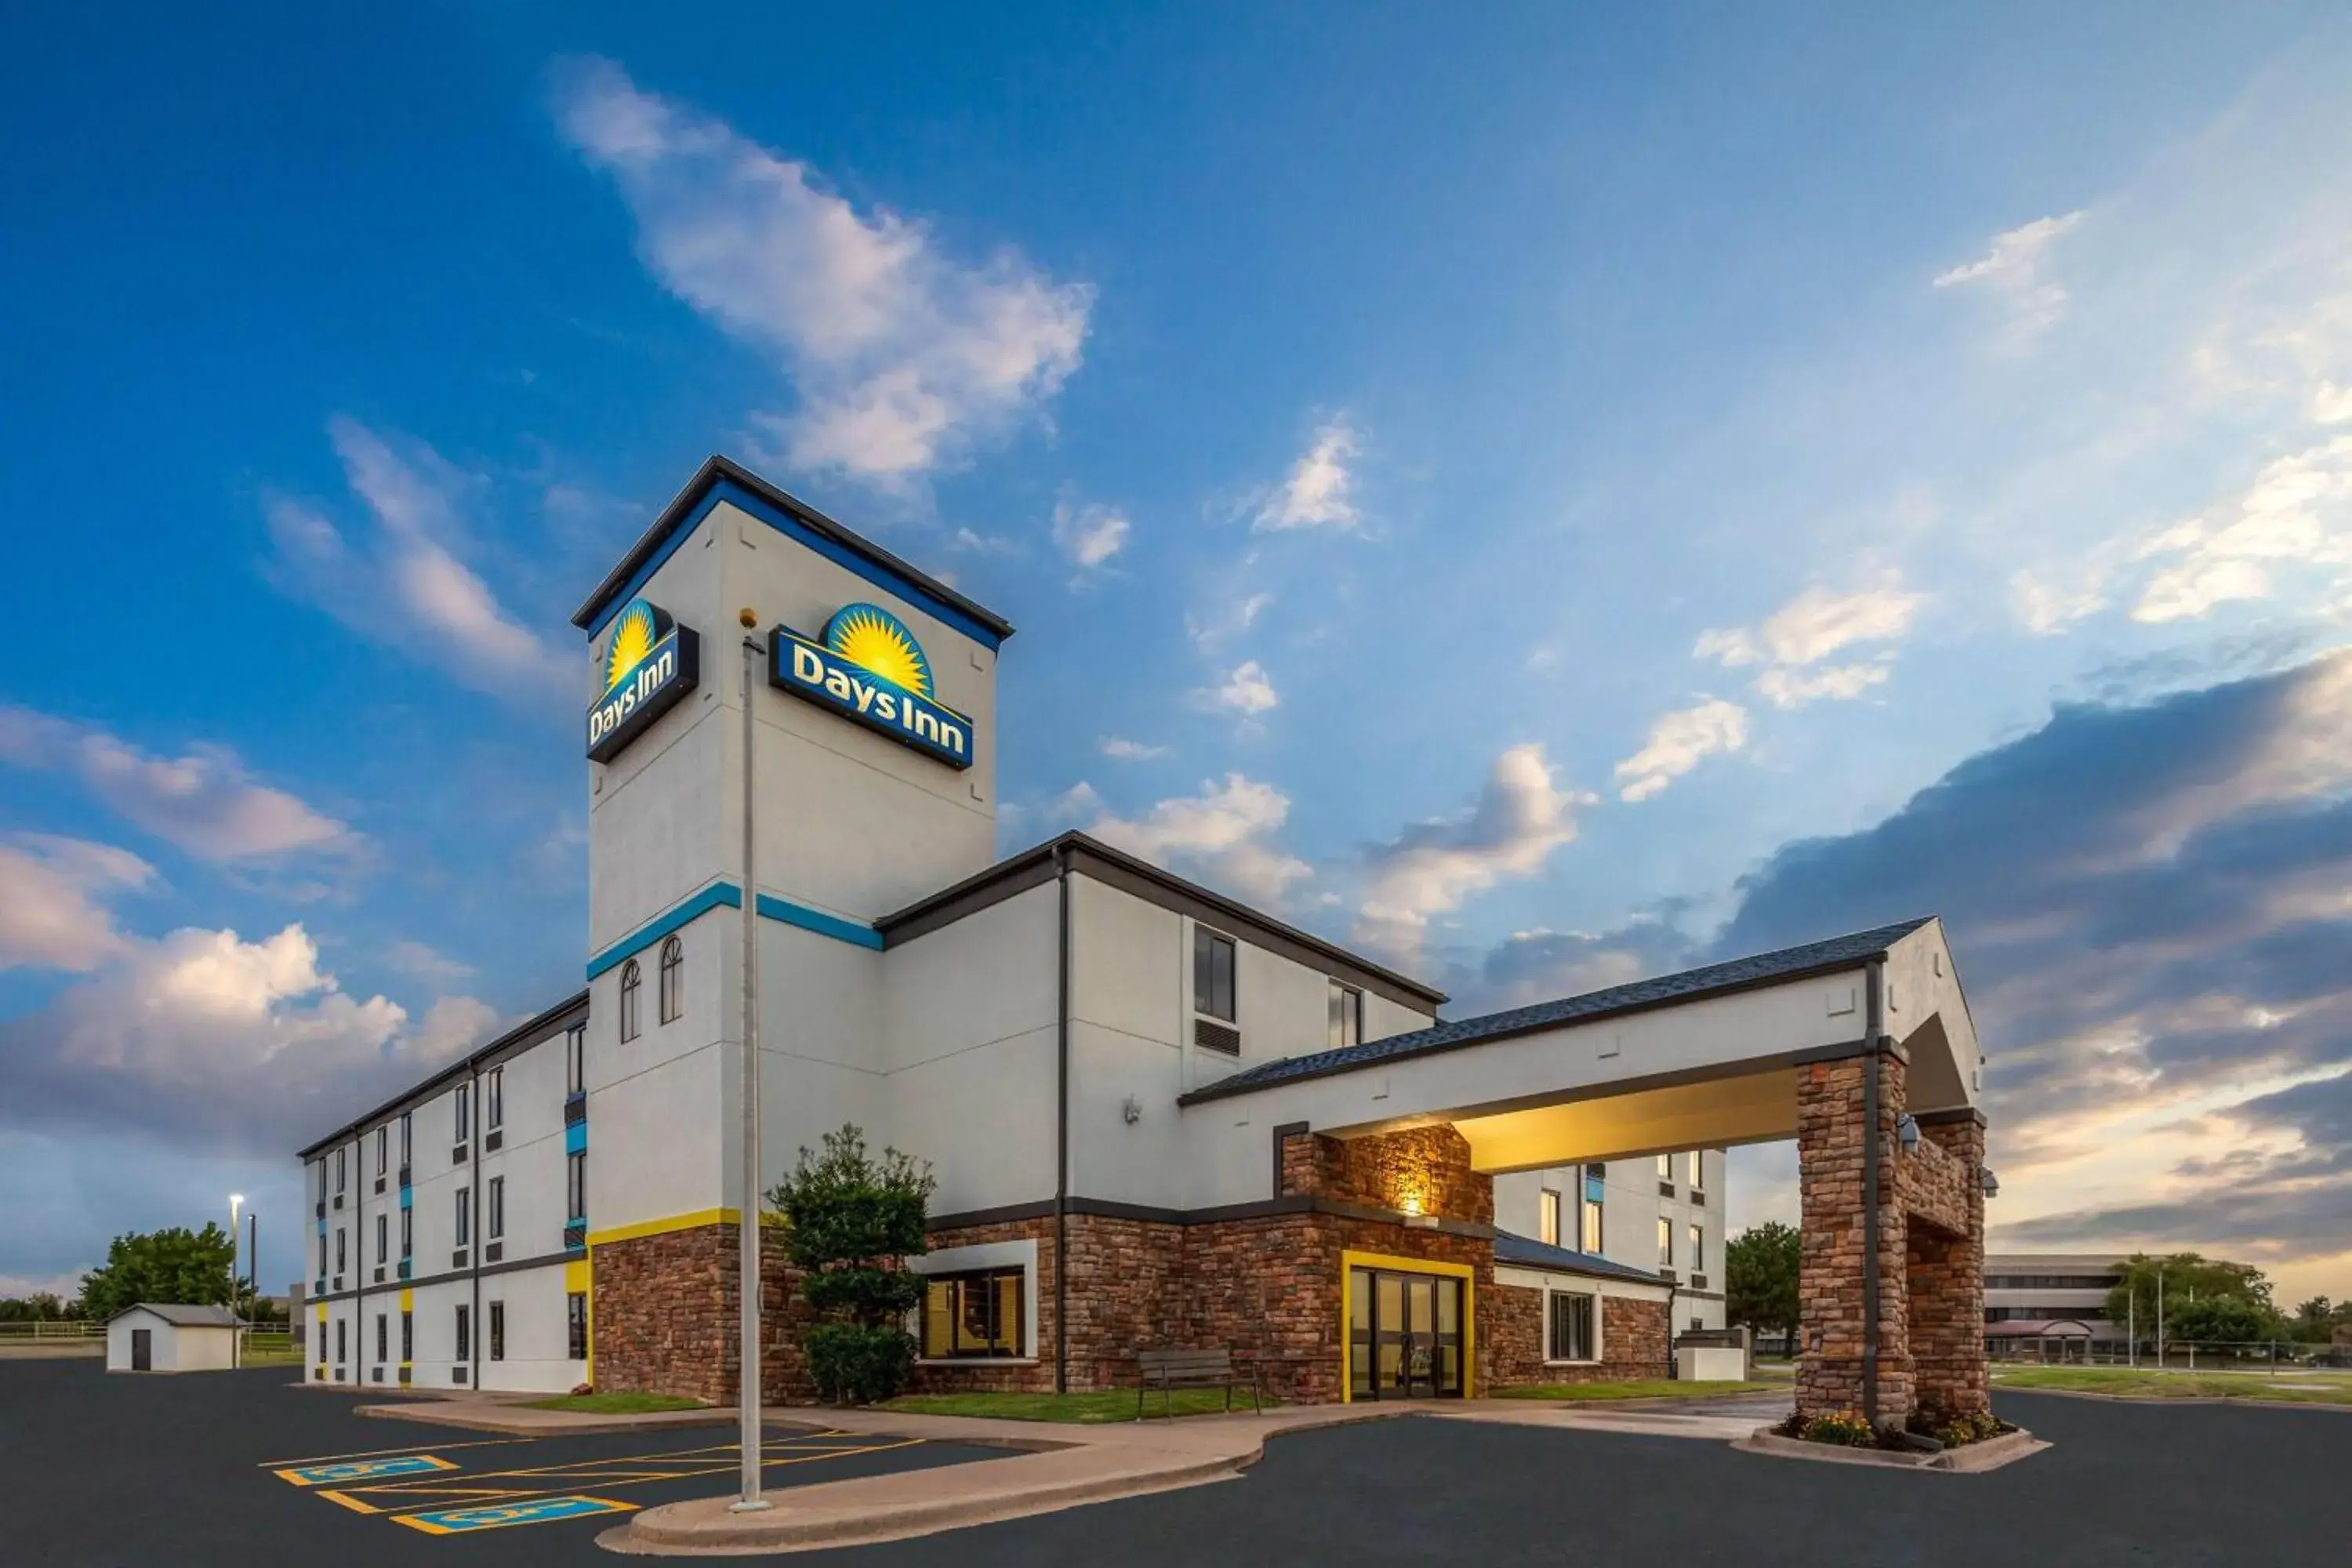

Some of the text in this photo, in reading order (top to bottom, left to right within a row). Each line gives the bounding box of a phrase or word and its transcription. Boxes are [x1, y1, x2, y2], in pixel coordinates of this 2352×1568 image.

[590, 650, 672, 745] Days Inn
[794, 644, 964, 754] Days Inn
